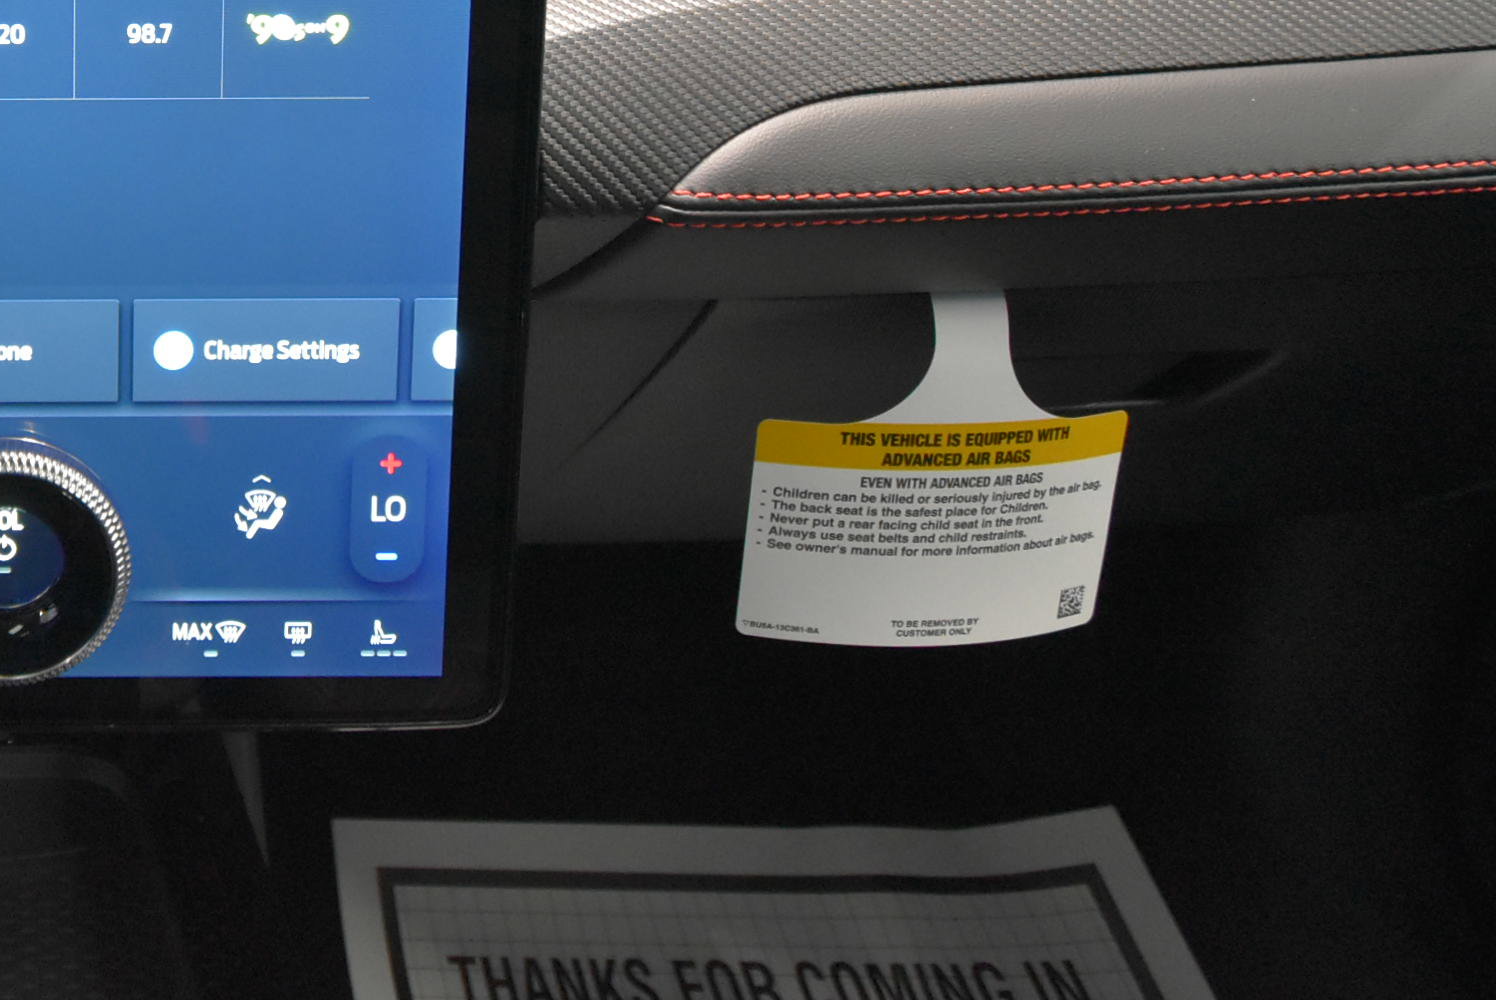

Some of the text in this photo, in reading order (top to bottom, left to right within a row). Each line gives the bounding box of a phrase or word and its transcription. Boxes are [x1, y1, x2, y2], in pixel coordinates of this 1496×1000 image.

[127, 23, 173, 44] 98.7
[203, 339, 360, 363] Charge Settings
[841, 426, 1070, 447] THIS VEHICLE IS EQUIPPED WITH
[882, 450, 1031, 467] ADVANCED AIR BAGS
[860, 472, 1043, 489] EVEN WITH ADVANCED AIR BAGS
[772, 486, 830, 501] Children
[833, 493, 857, 502] can
[861, 493, 877, 503] be
[880, 493, 914, 504] killed
[917, 495, 930, 504] or
[934, 492, 988, 505] seriously
[992, 488, 1030, 503] injured
[1034, 488, 1046, 500] by
[1049, 486, 1065, 497] the
[1067, 483, 1081, 495] air
[370, 495, 407, 523] LO
[771, 499, 1048, 519] The back seat is the safest place for Children.
[770, 513, 1043, 532] Never put a rear facing child seat in the front.
[768, 525, 1027, 544] Always use seat belts and child restraints.
[767, 538, 792, 550] See
[795, 542, 847, 555] owner's
[851, 545, 897, 556] manual
[901, 545, 918, 557] for
[922, 547, 952, 557] more
[956, 541, 1020, 556] information
[1023, 538, 1052, 551] about
[1055, 535, 1068, 546] air
[172, 623, 212, 642] MAX
[891, 617, 979, 628] TO BE REMOVED BY
[896, 627, 973, 638] CUSTOMER ONLY
[447, 955, 1094, 1000] THANKS FOR COMING IN
